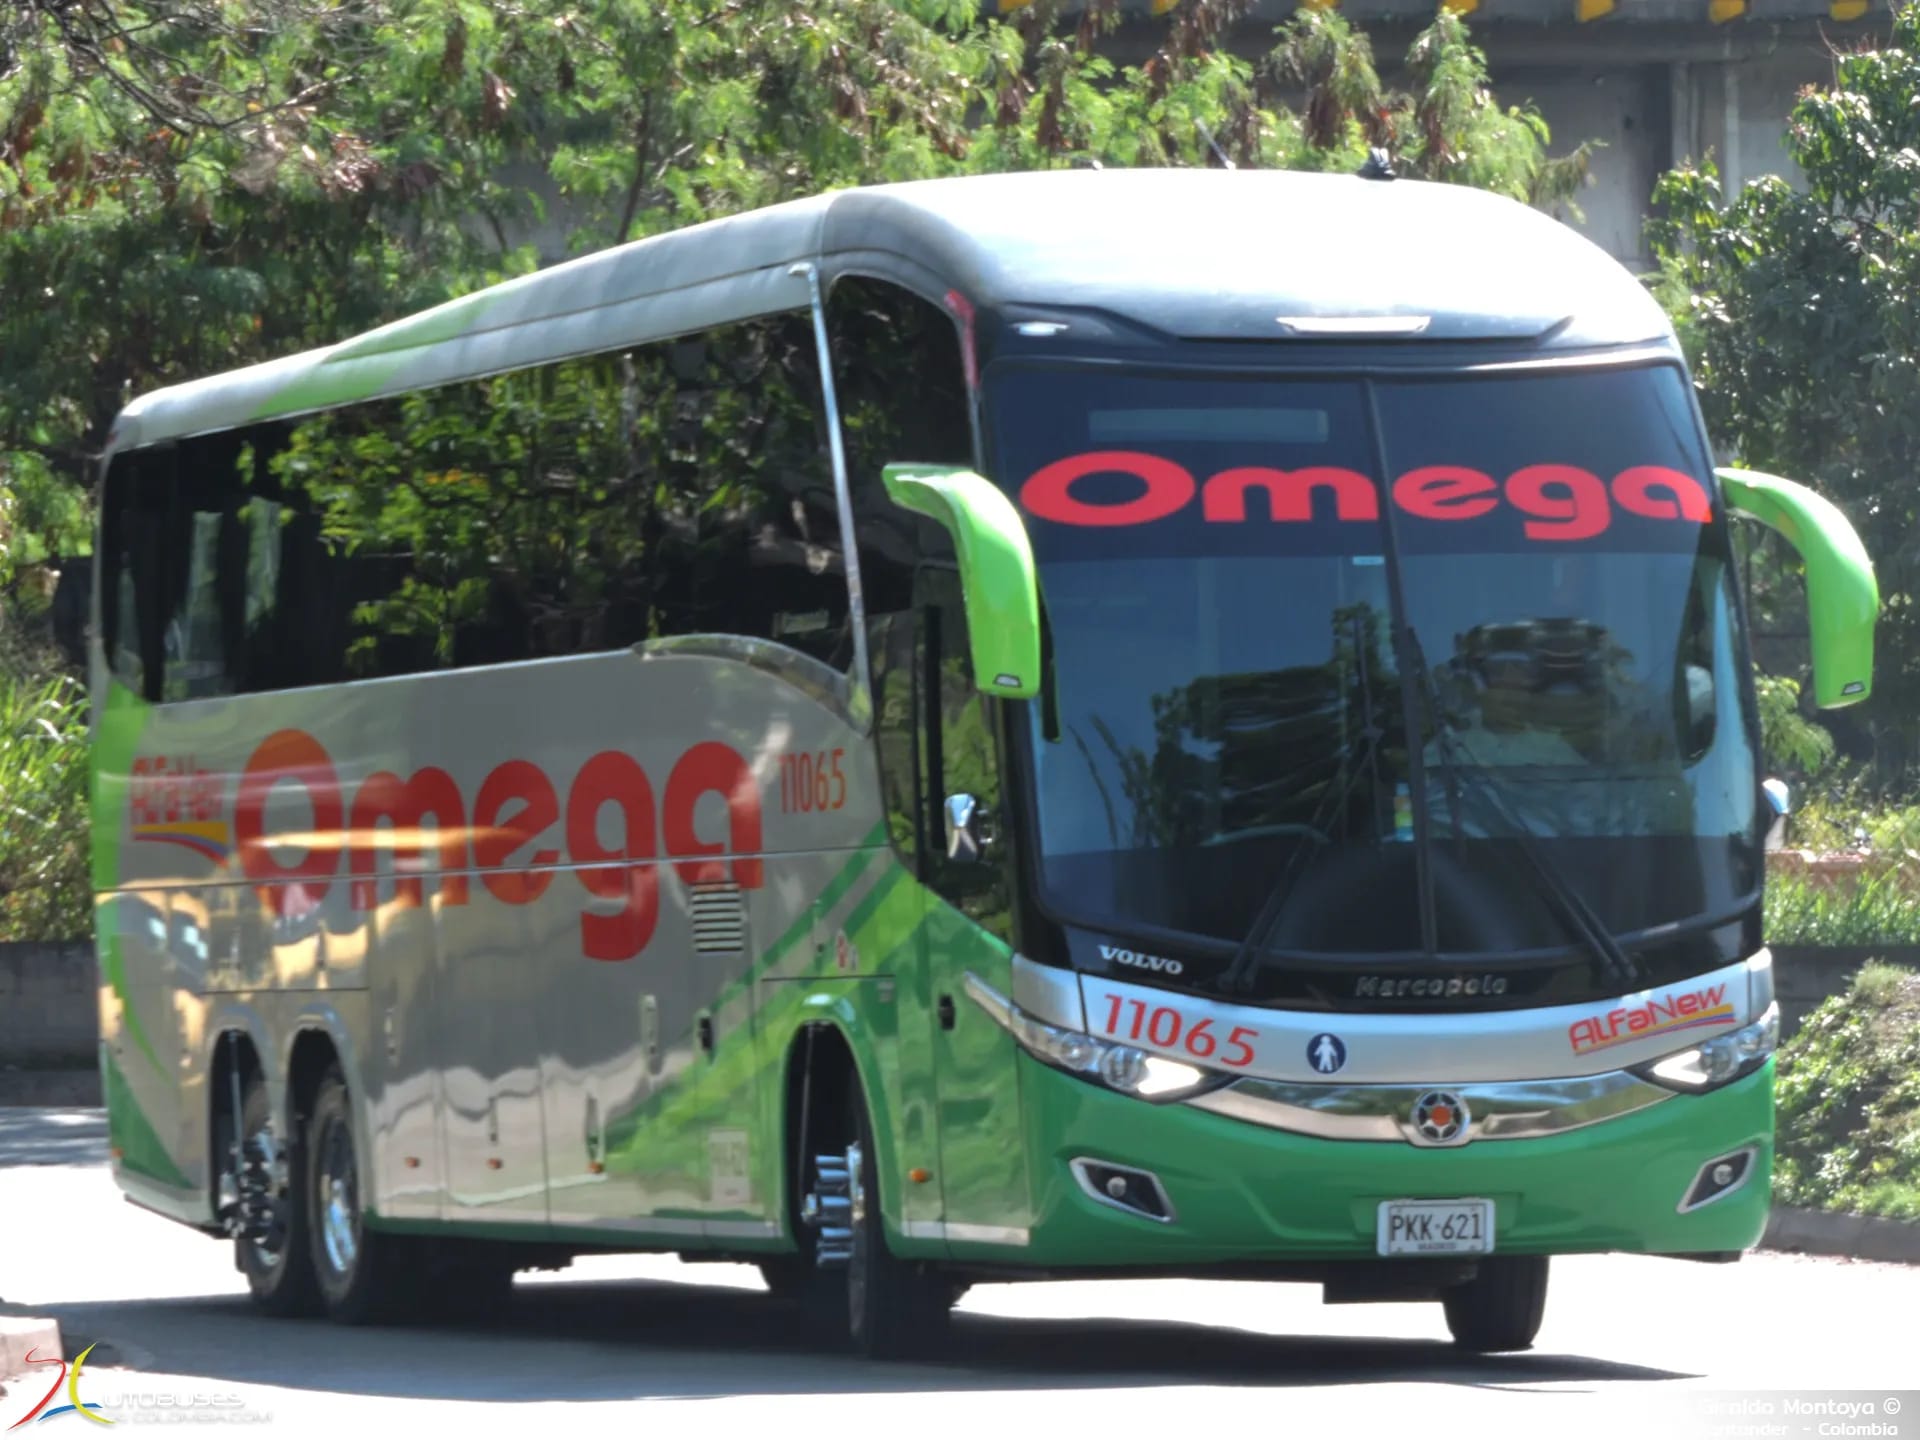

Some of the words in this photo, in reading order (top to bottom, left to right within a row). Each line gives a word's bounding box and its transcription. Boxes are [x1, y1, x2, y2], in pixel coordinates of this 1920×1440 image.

[1021, 450, 1713, 541] Omega
[777, 746, 848, 815] 11065
[233, 728, 763, 962] Omega
[1098, 944, 1184, 975] VOLVO
[1354, 974, 1508, 998] Marcopolo
[1105, 993, 1260, 1067] 11065
